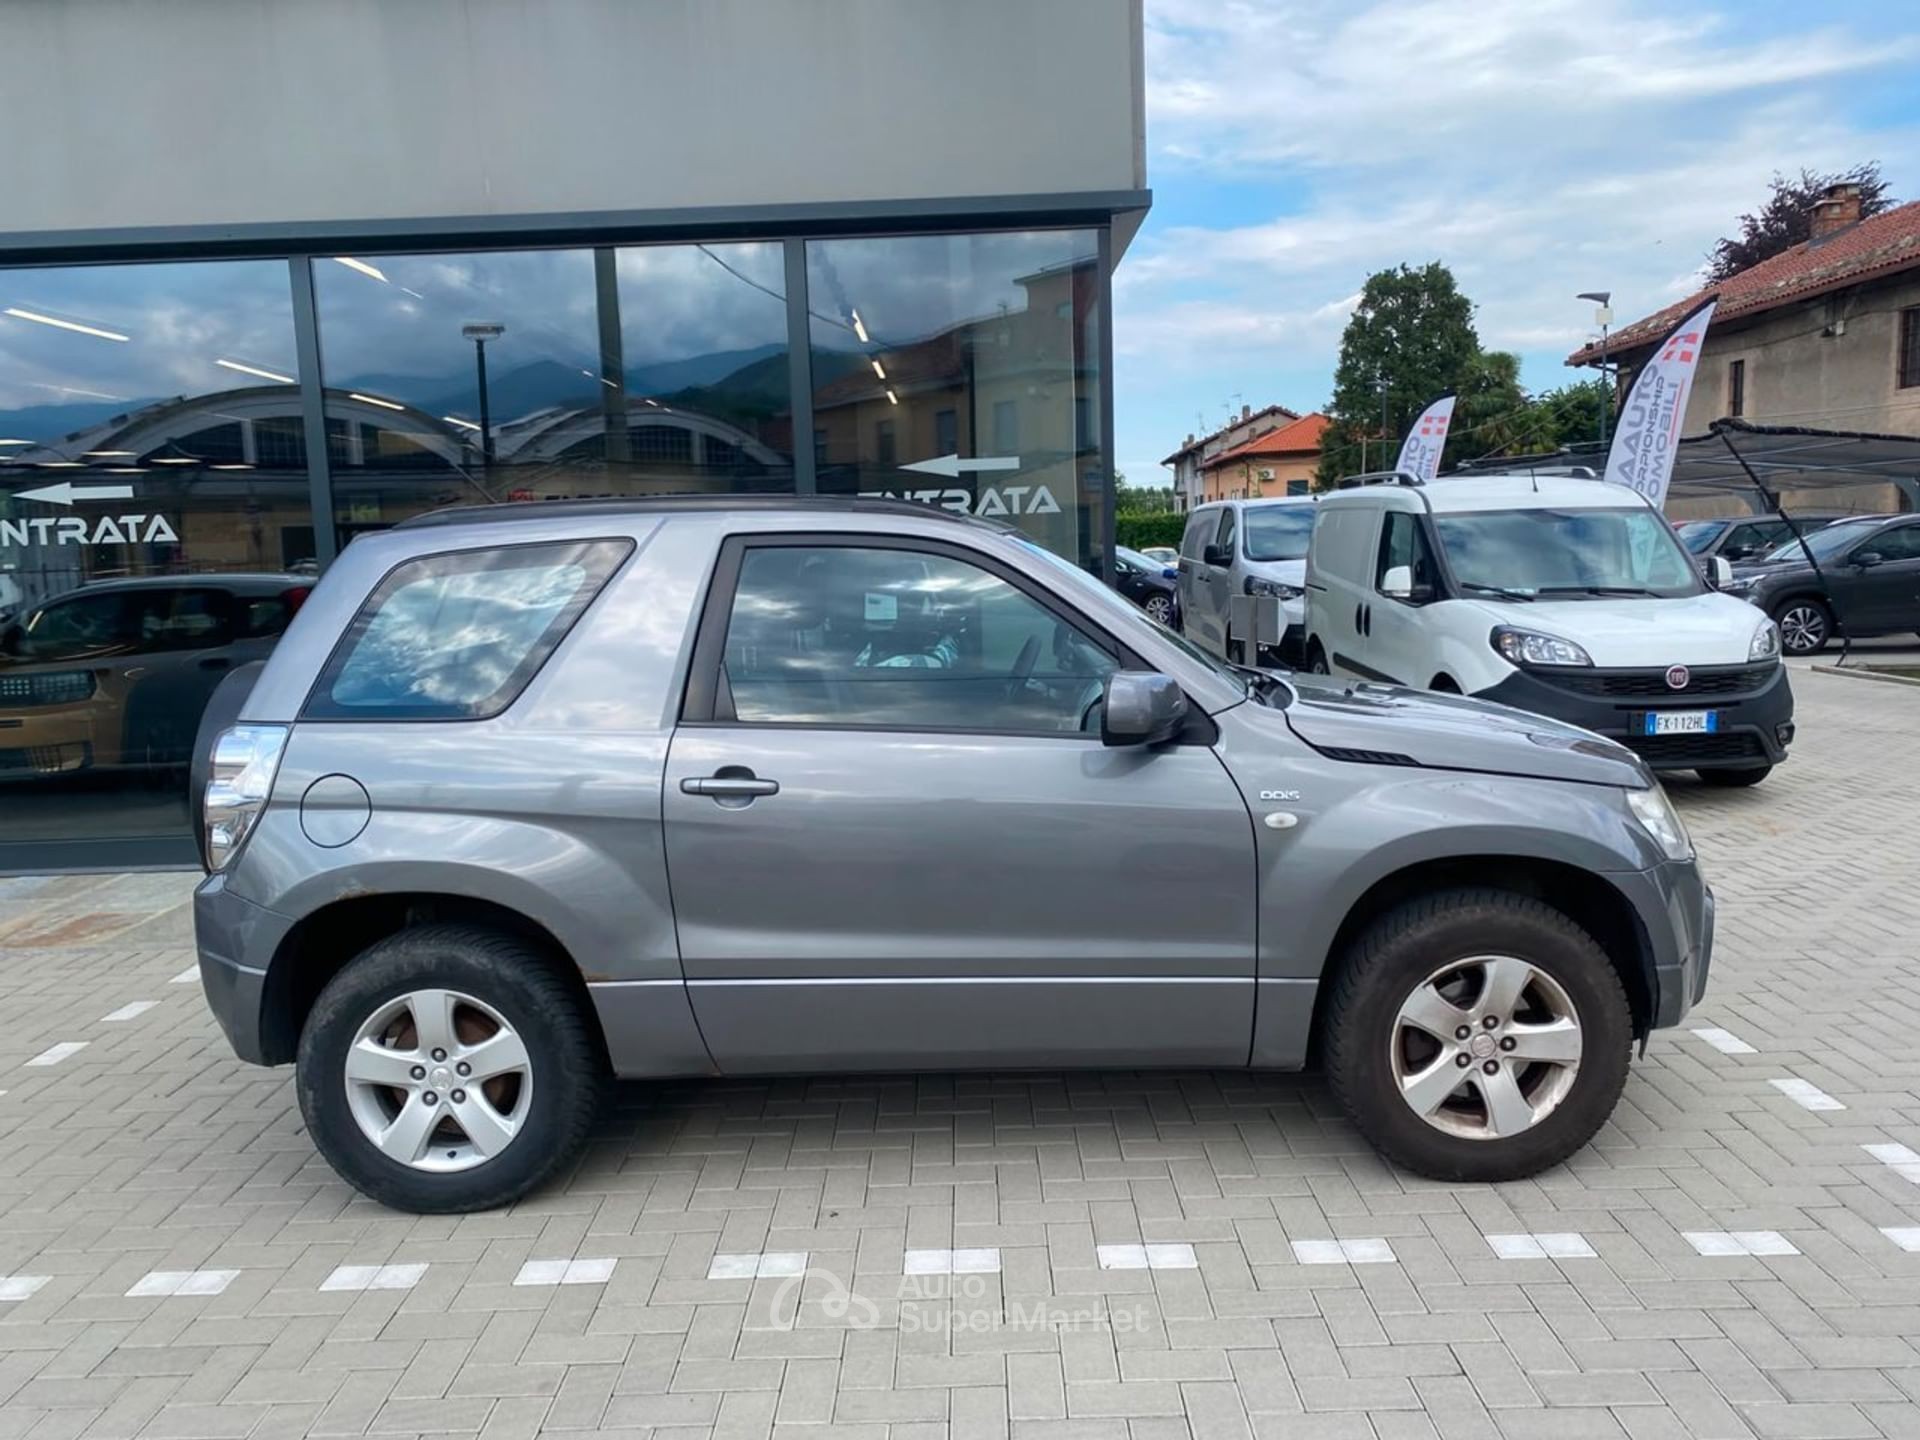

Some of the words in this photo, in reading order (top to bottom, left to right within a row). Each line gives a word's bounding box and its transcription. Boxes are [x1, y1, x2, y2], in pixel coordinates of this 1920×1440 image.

[1617, 364, 1659, 487] AAUTO
[1648, 382, 1679, 498] OMOBILI
[0, 514, 179, 547] NTRATA
